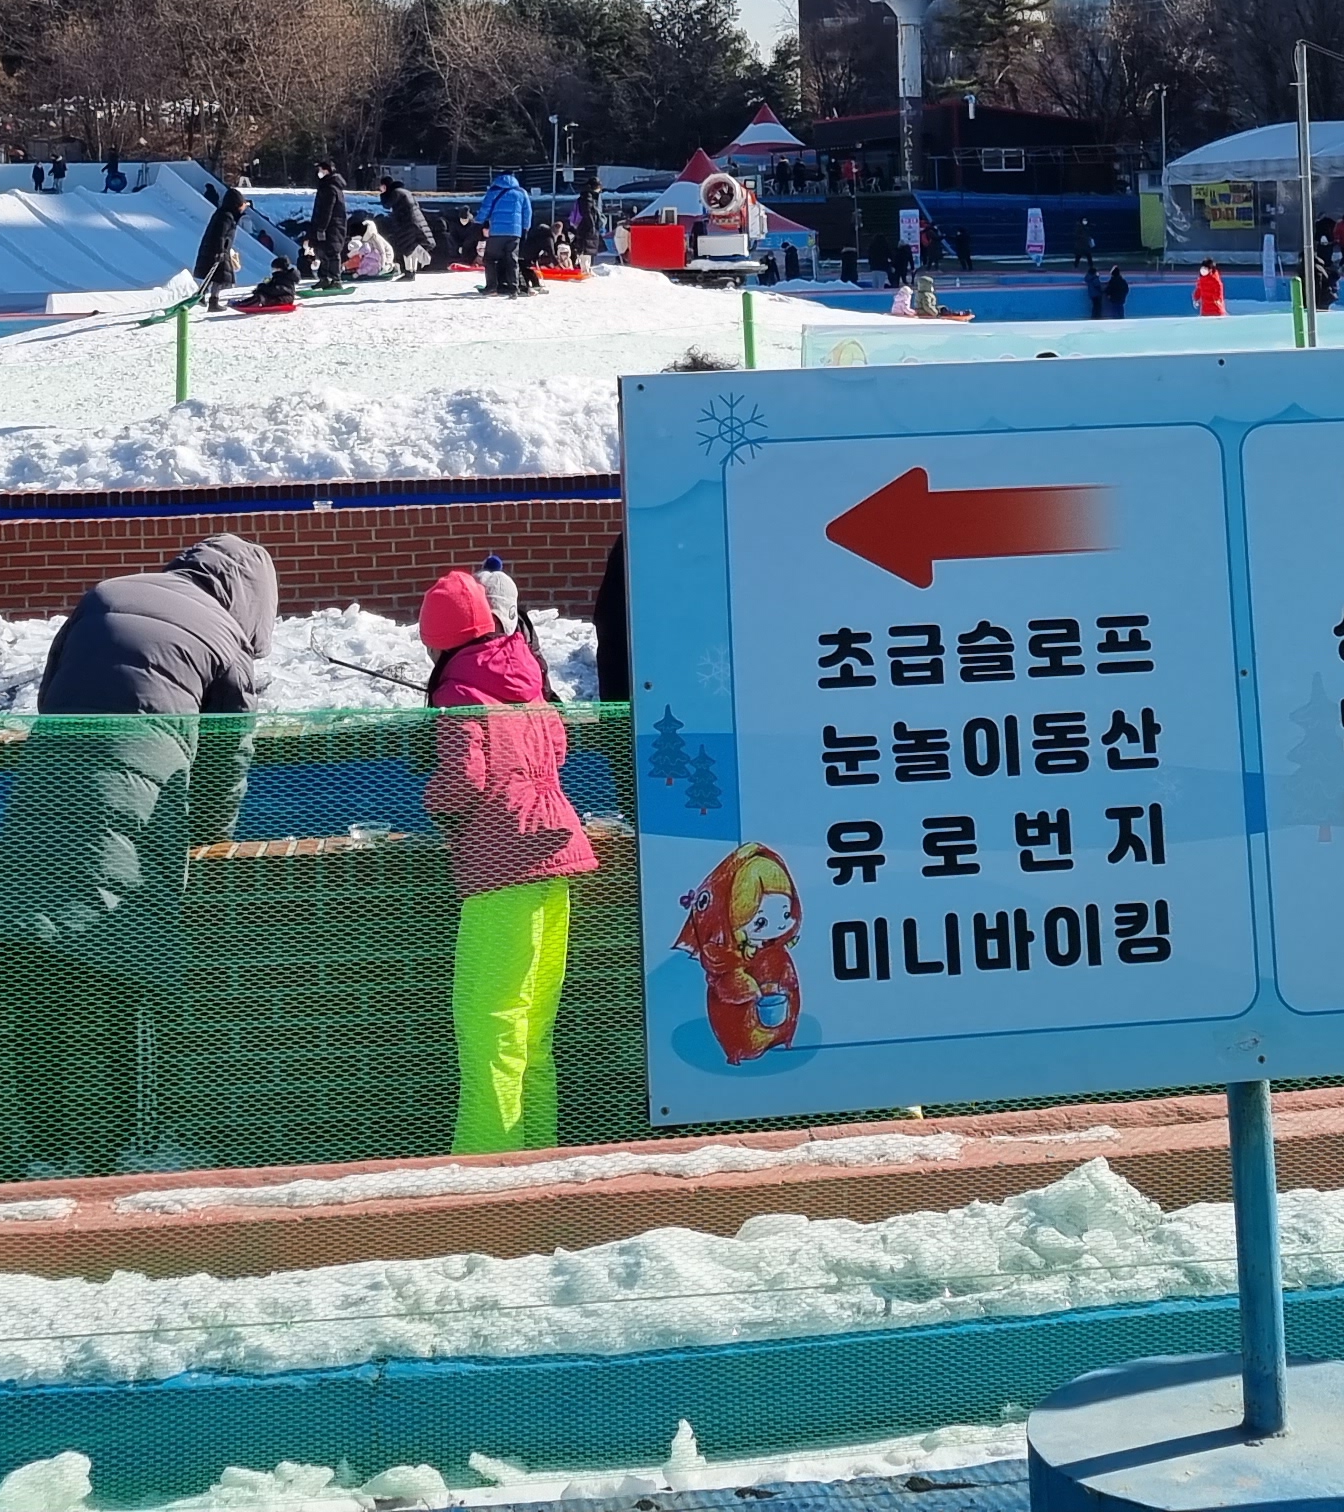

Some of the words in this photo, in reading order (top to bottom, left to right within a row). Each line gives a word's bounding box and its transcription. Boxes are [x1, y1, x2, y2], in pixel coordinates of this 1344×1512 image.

[817, 614, 1155, 689] 초급슬로프
[821, 707, 1162, 787] 눈놀이동산
[831, 899, 1172, 981] 미니바이킹
